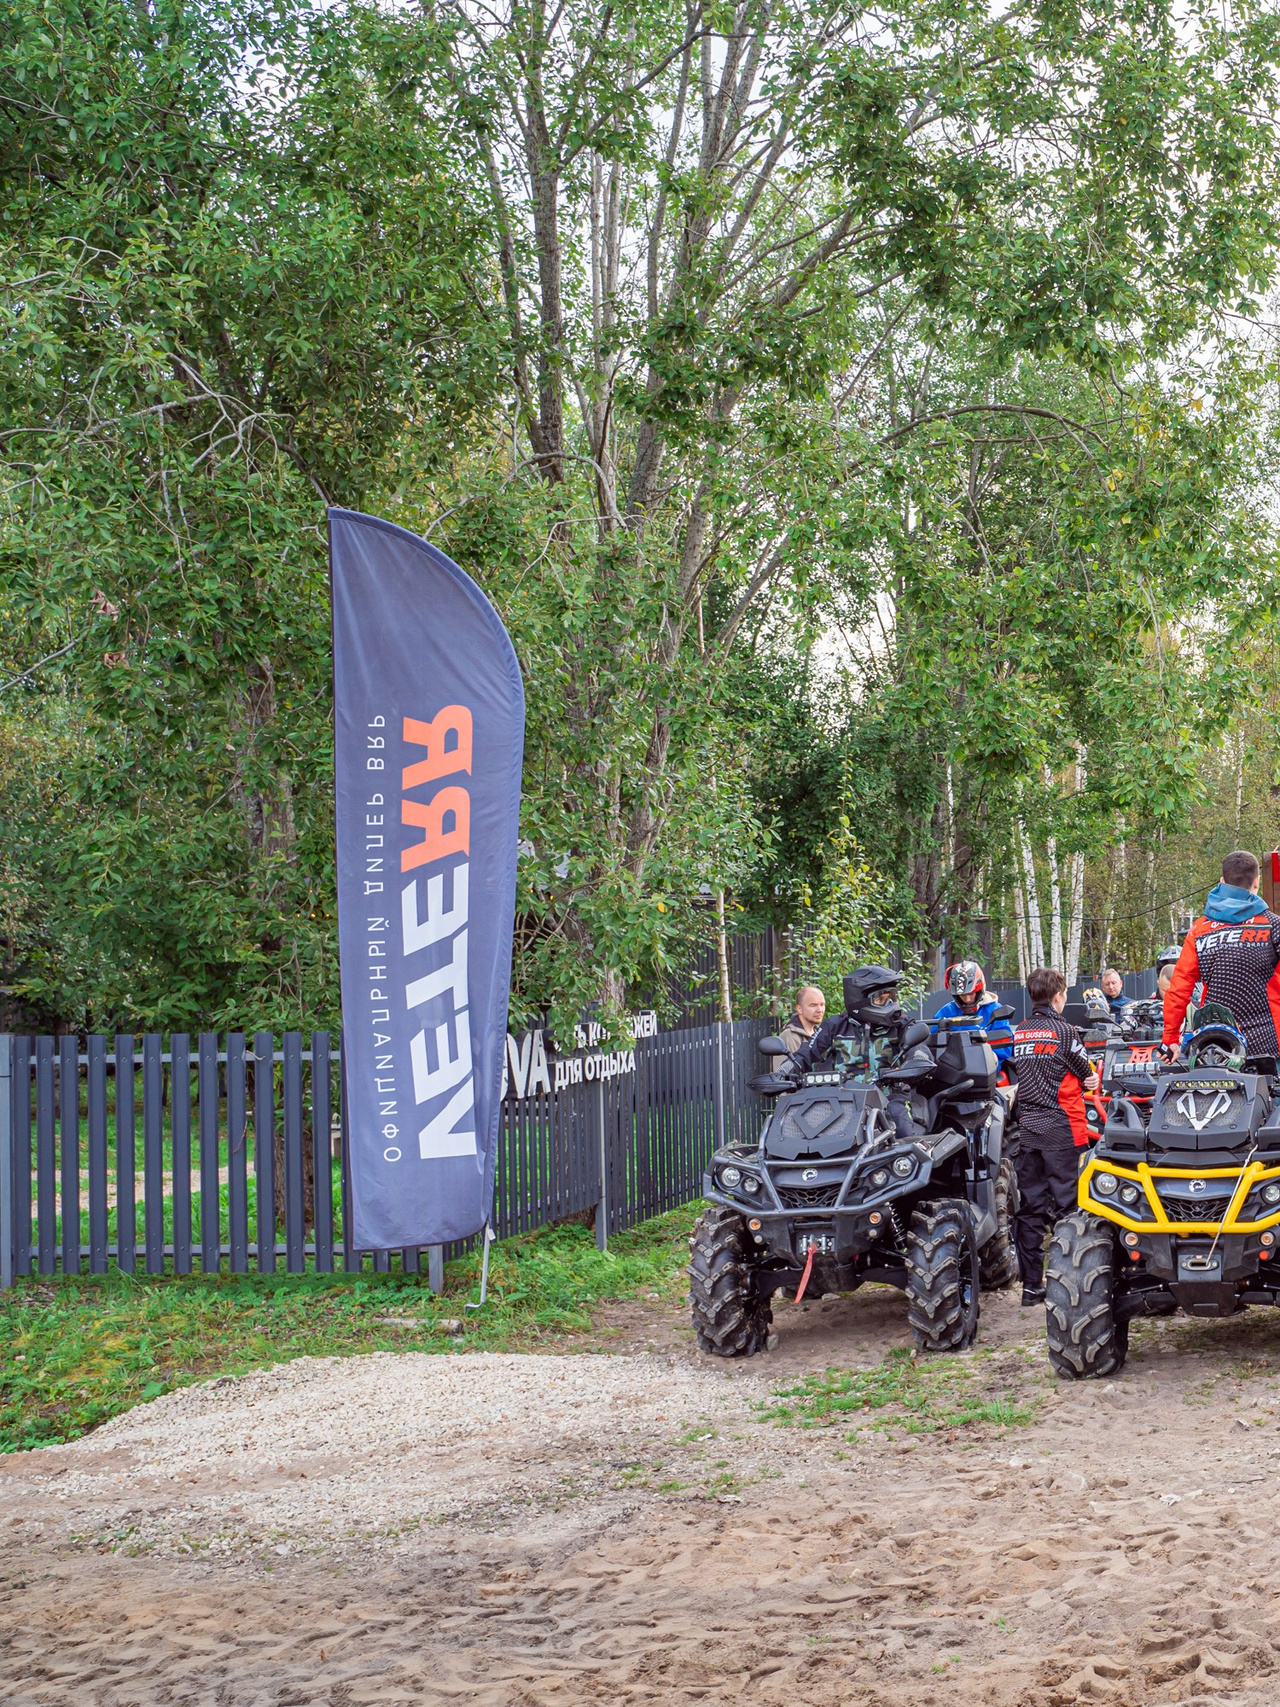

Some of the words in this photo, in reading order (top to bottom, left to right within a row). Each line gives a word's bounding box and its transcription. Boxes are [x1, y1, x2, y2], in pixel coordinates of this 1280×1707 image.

[1195, 929, 1271, 953] VETERR
[1025, 1031, 1052, 1039] GUSEVA
[1014, 1042, 1058, 1058] ETERR
[554, 1058, 583, 1092] ДЛЯ
[584, 1050, 636, 1082] ОТДЫХА
